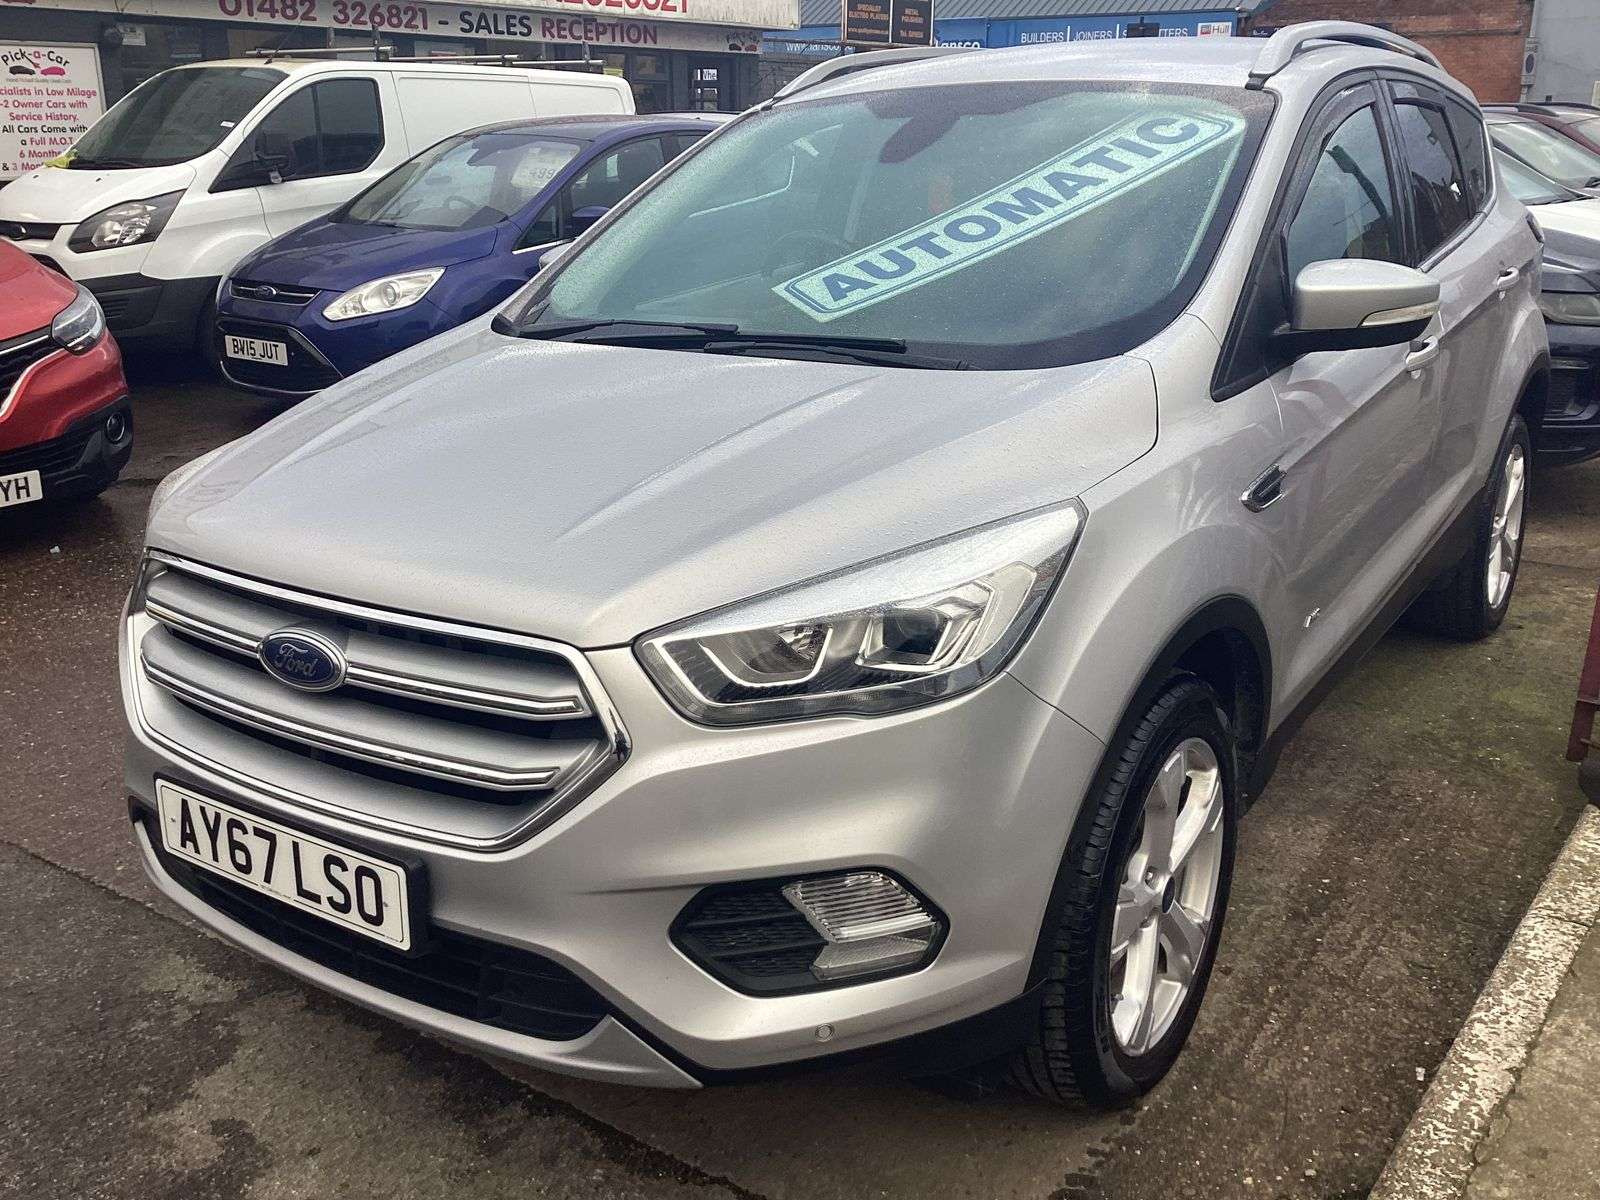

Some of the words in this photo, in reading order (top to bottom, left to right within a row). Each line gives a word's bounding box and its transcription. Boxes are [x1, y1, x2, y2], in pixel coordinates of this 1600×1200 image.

[219, 0, 317, 22] 01482
[333, 0, 428, 30] 326821
[460, 11, 532, 37] SALES
[541, 17, 658, 45] RECEPTION
[1021, 32, 1064, 43] BUILDERS
[1074, 31, 1113, 41] JOINERS
[34, 86, 43, 96] in
[46, 88, 64, 96] Low
[67, 88, 97, 98] Milage
[12, 99, 43, 108] Owner
[46, 100, 66, 108] Cars
[69, 100, 88, 108] with
[9, 112, 43, 121] Service
[45, 112, 79, 122] History.
[2, 125, 14, 133] All
[18, 125, 38, 133] Cars
[41, 125, 67, 133] Come
[70, 125, 88, 133] with
[19, 150, 26, 158] 6
[2, 163, 9, 171] &
[822, 116, 1202, 301] AUTOMATIC
[259, 342, 279, 360] JUT
[274, 642, 318, 677] Ford
[180, 797, 277, 884] AY67
[291, 840, 384, 927] LSO
